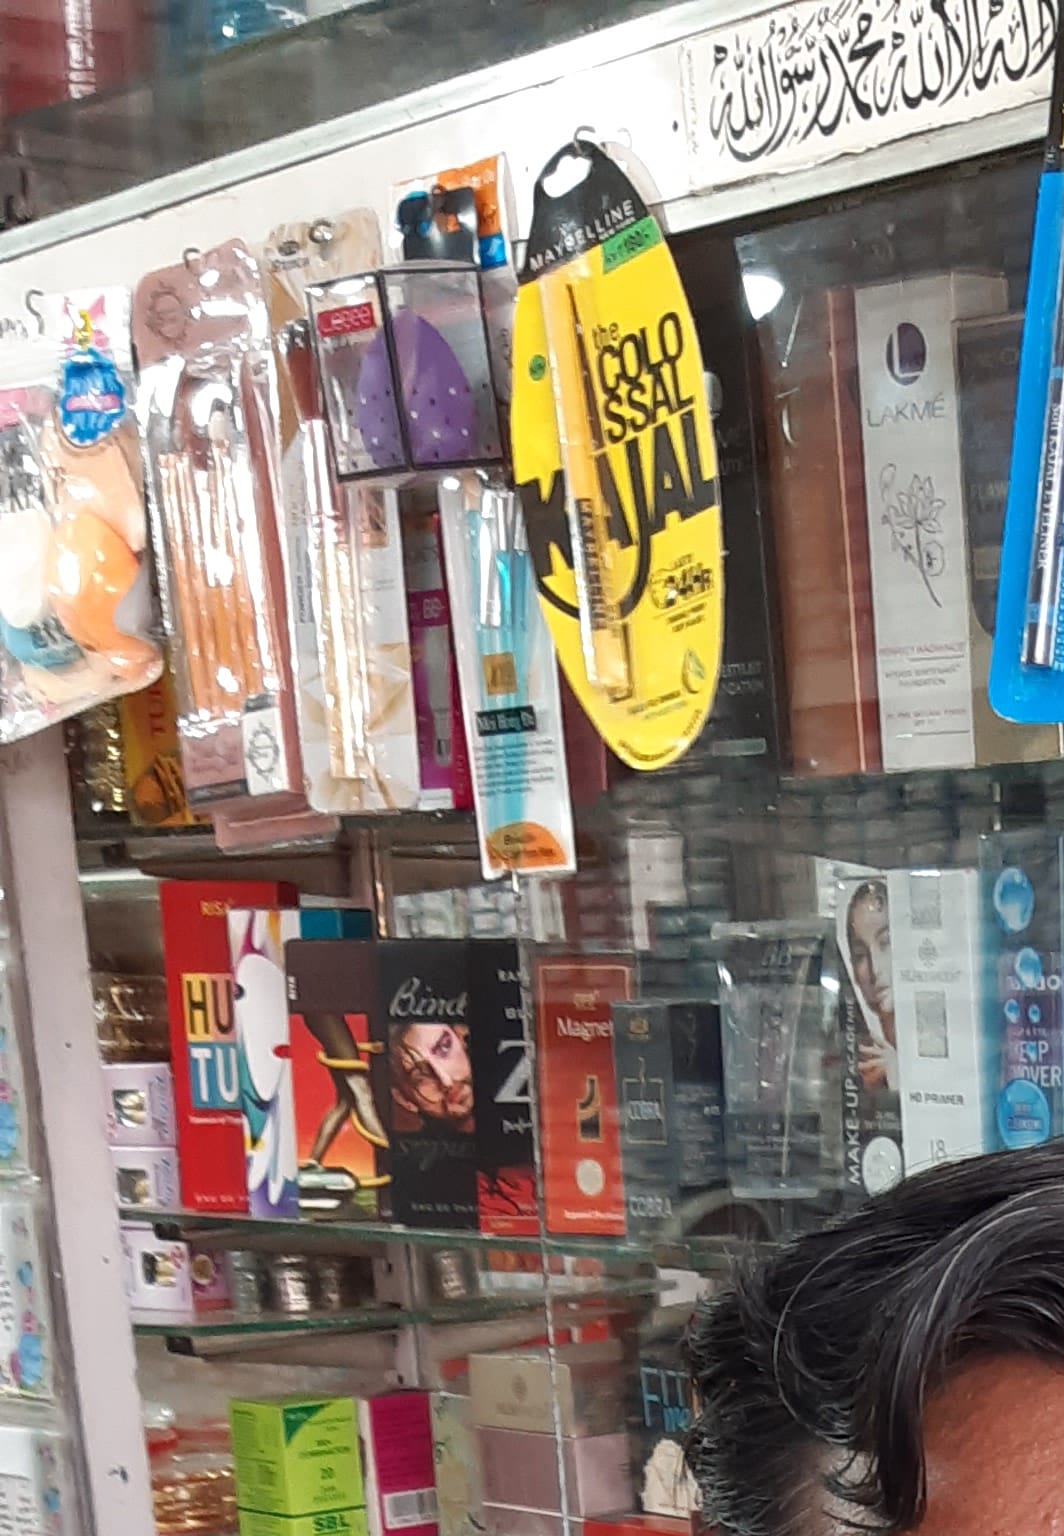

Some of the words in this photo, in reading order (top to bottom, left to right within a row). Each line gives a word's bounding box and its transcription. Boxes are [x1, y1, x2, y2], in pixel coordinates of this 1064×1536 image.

[528, 200, 634, 272] MAYBELLINE
[592, 323, 620, 349] the
[598, 312, 684, 396] COLO
[603, 361, 696, 444] SSAL
[516, 409, 718, 620] KAJAL
[186, 978, 234, 1035] HU
[190, 1046, 241, 1104] TU
[925, 1092, 965, 1106] PRIMER
[845, 1077, 863, 1187] MAKE-UP
[313, 1514, 350, 1532] SBL
